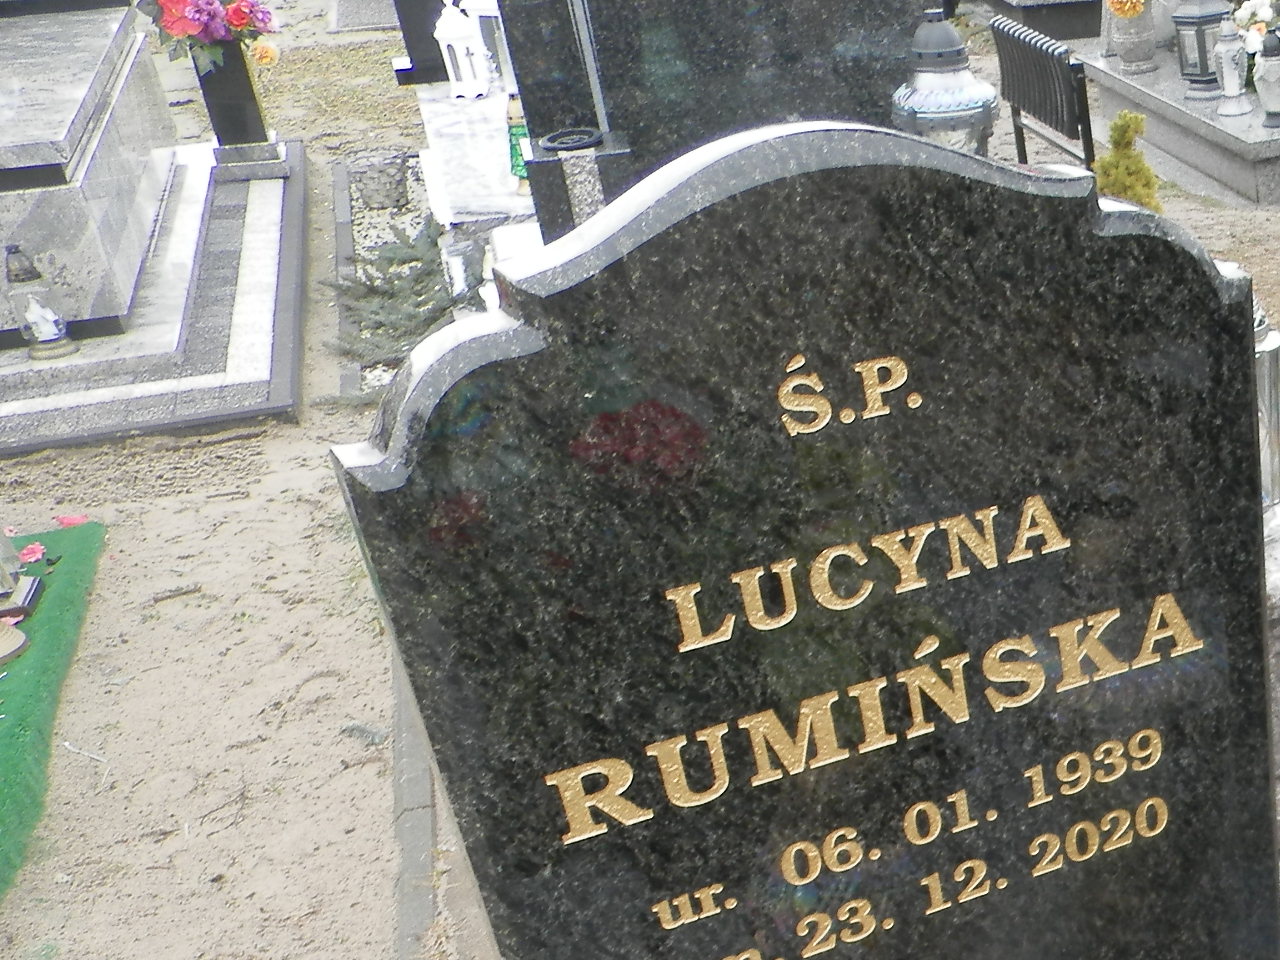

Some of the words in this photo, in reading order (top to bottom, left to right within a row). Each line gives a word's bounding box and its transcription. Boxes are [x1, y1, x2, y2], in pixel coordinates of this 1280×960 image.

[776, 353, 923, 438] Ś.P.
[663, 493, 1073, 654] LUCYNA
[544, 591, 1205, 846] RUMIŃSKA
[650, 881, 739, 932] ur.
[778, 825, 883, 887] 06.
[901, 787, 1000, 848] 01.
[1022, 727, 1164, 809] 1939
[794, 897, 897, 960] 23.
[918, 857, 1010, 917] 12.
[1027, 795, 1171, 879] 2020
